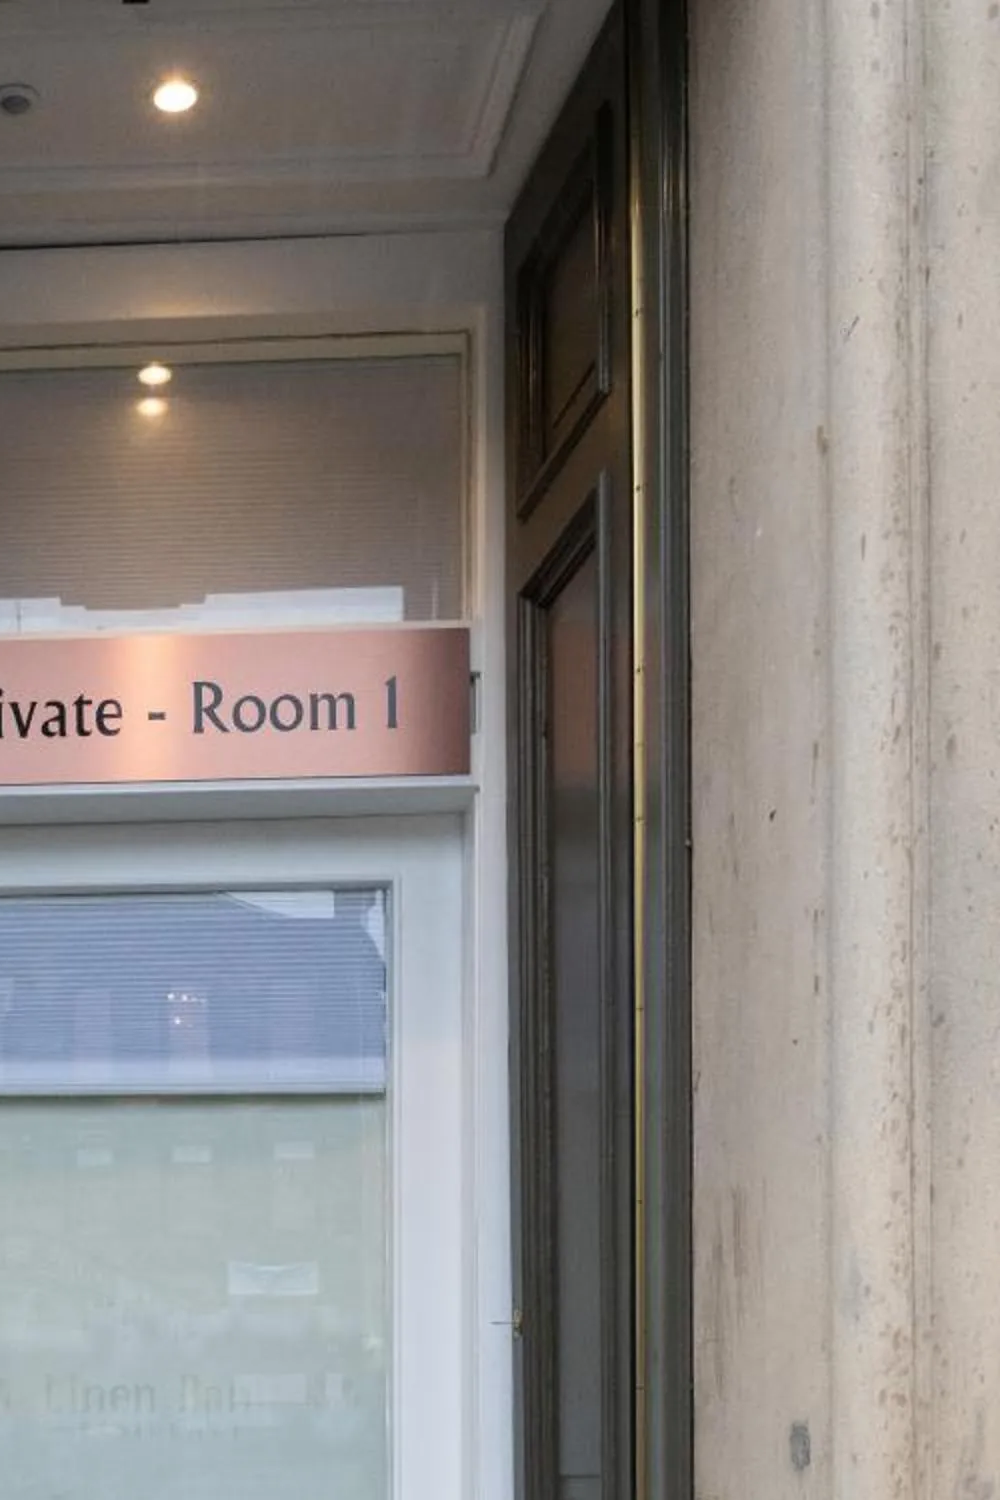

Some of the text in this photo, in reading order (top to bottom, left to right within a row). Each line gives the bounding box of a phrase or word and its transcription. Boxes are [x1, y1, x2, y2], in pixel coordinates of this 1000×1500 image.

[148, 711, 167, 721] -
[193, 681, 356, 734] Room
[384, 676, 398, 730] 1
